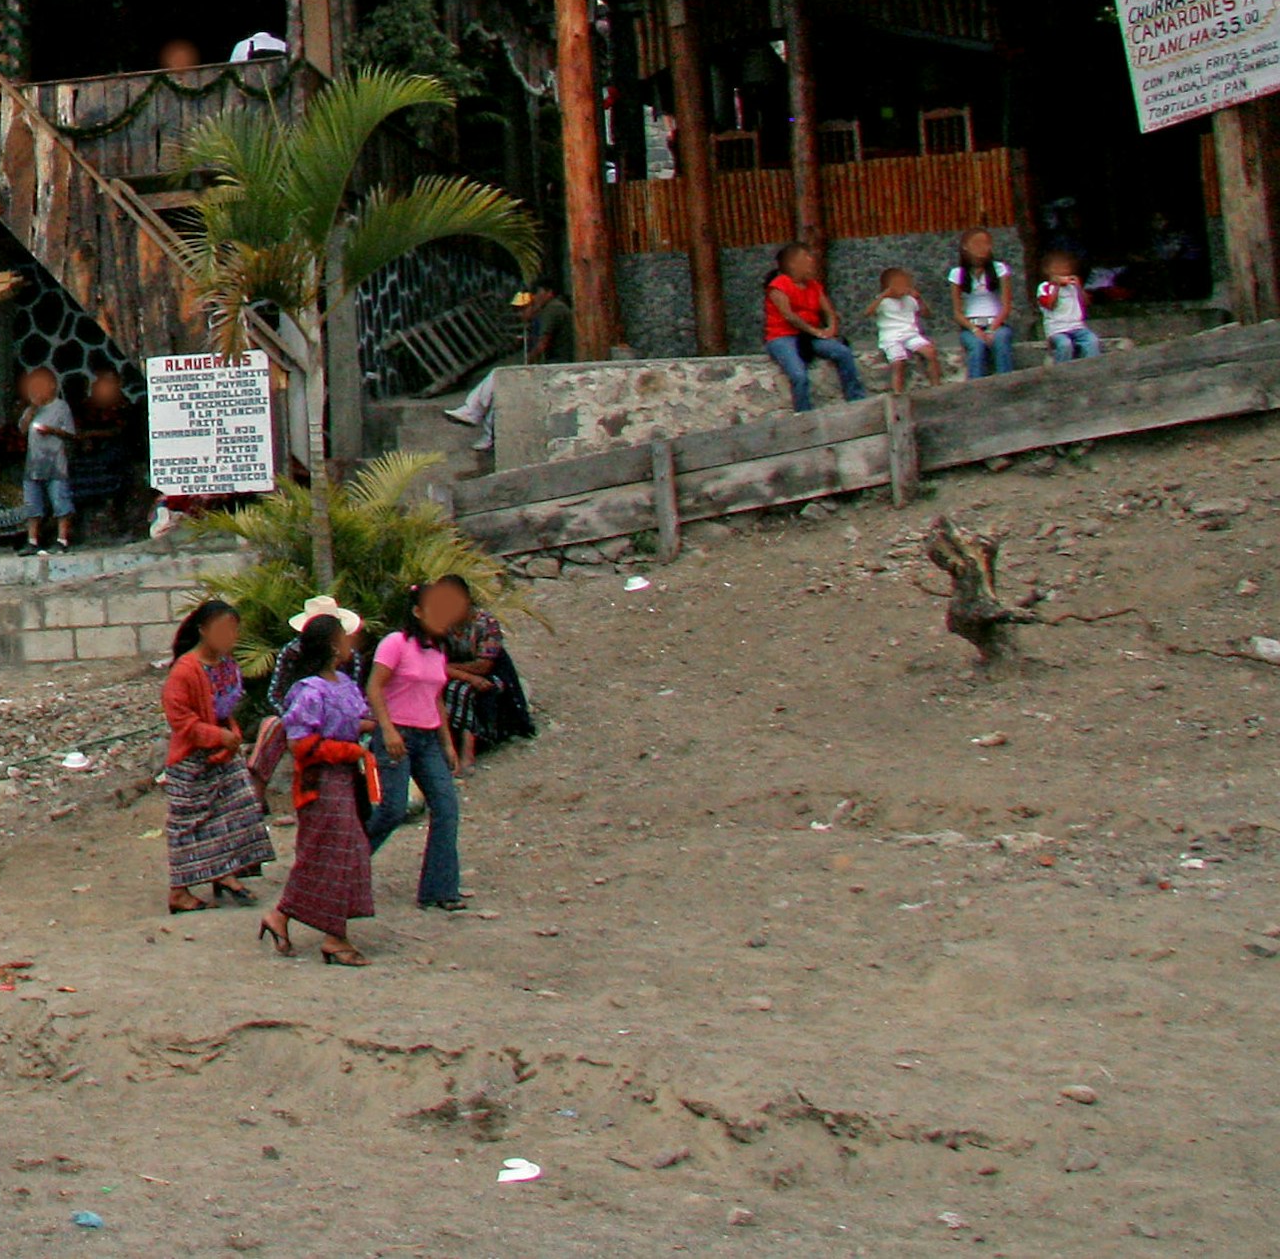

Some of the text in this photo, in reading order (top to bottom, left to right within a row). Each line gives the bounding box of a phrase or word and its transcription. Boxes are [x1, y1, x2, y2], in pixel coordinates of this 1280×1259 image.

[1138, 28, 1211, 64] PLANCHA
[1143, 77, 1163, 91] CON
[1168, 64, 1201, 82] PAPAS
[1148, 94, 1208, 120] TORTILLAS
[1225, 79, 1248, 95] PAN
[150, 372, 215, 385] CHURRASCOS
[152, 389, 261, 403] POLLO ENCEBOLLADO
[189, 407, 266, 419] A LA PLANCHA
[189, 419, 223, 428] FRITO
[217, 428, 230, 436] AL
[235, 426, 256, 435] AJO
[216, 445, 259, 455] FRITOS
[153, 455, 257, 467] PESCADO Y FILETE
[171, 466, 217, 476] PESCADO
[157, 476, 190, 485] CALDO
[194, 475, 207, 484] DE
[181, 484, 235, 494] CEVICHES
